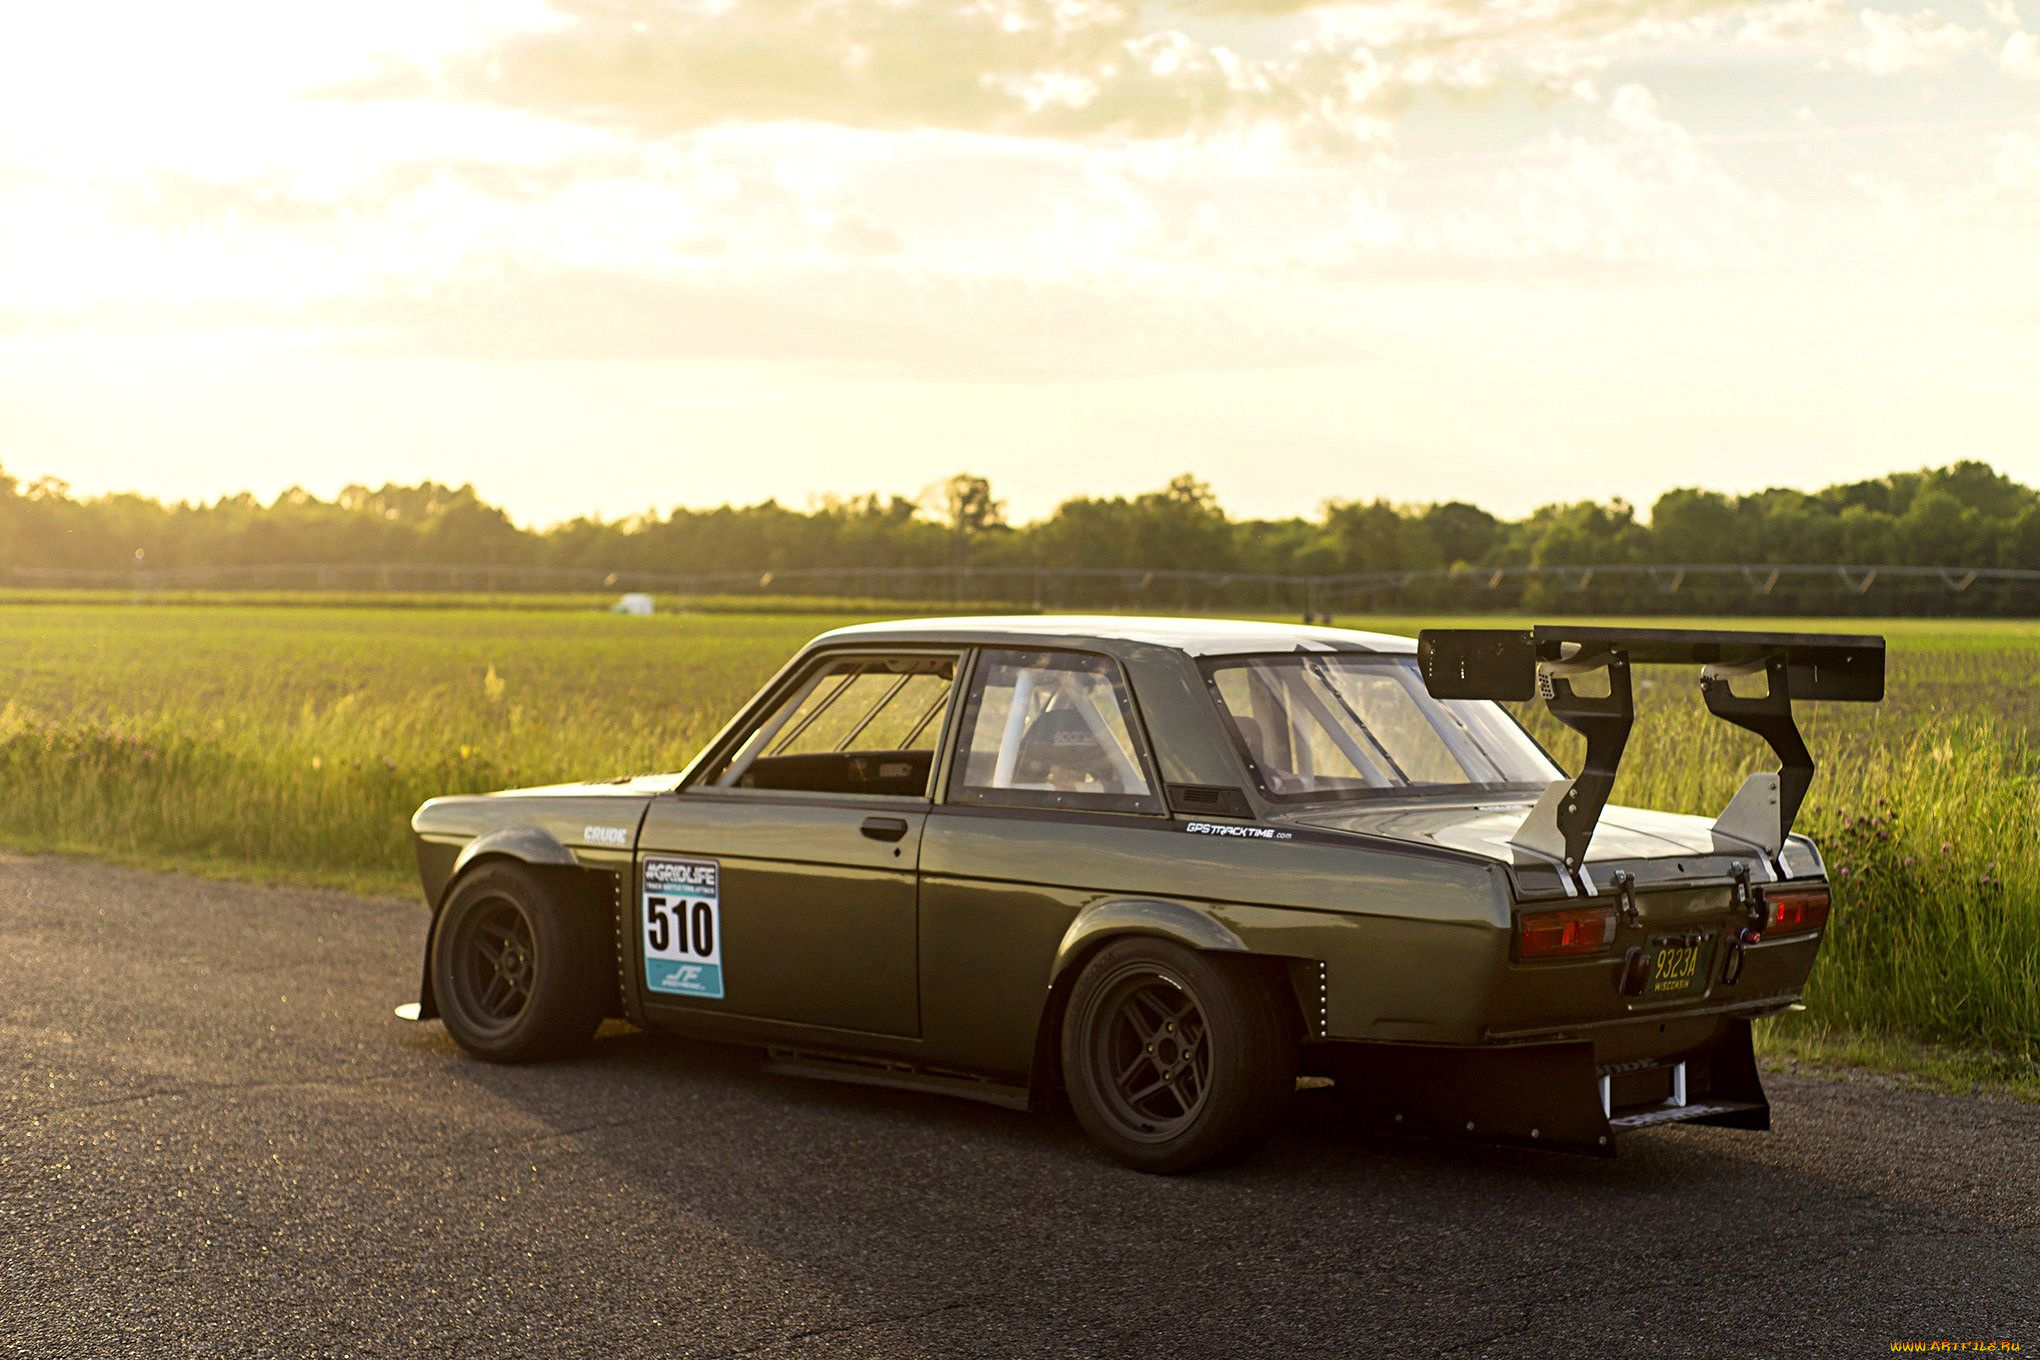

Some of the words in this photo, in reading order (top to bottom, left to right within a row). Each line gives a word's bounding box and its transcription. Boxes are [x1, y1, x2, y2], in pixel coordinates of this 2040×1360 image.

[584, 826, 627, 843] CRUDE
[645, 863, 716, 886] #GRIDLIFE
[648, 897, 713, 957] 510
[1655, 946, 1698, 979] 9323A
